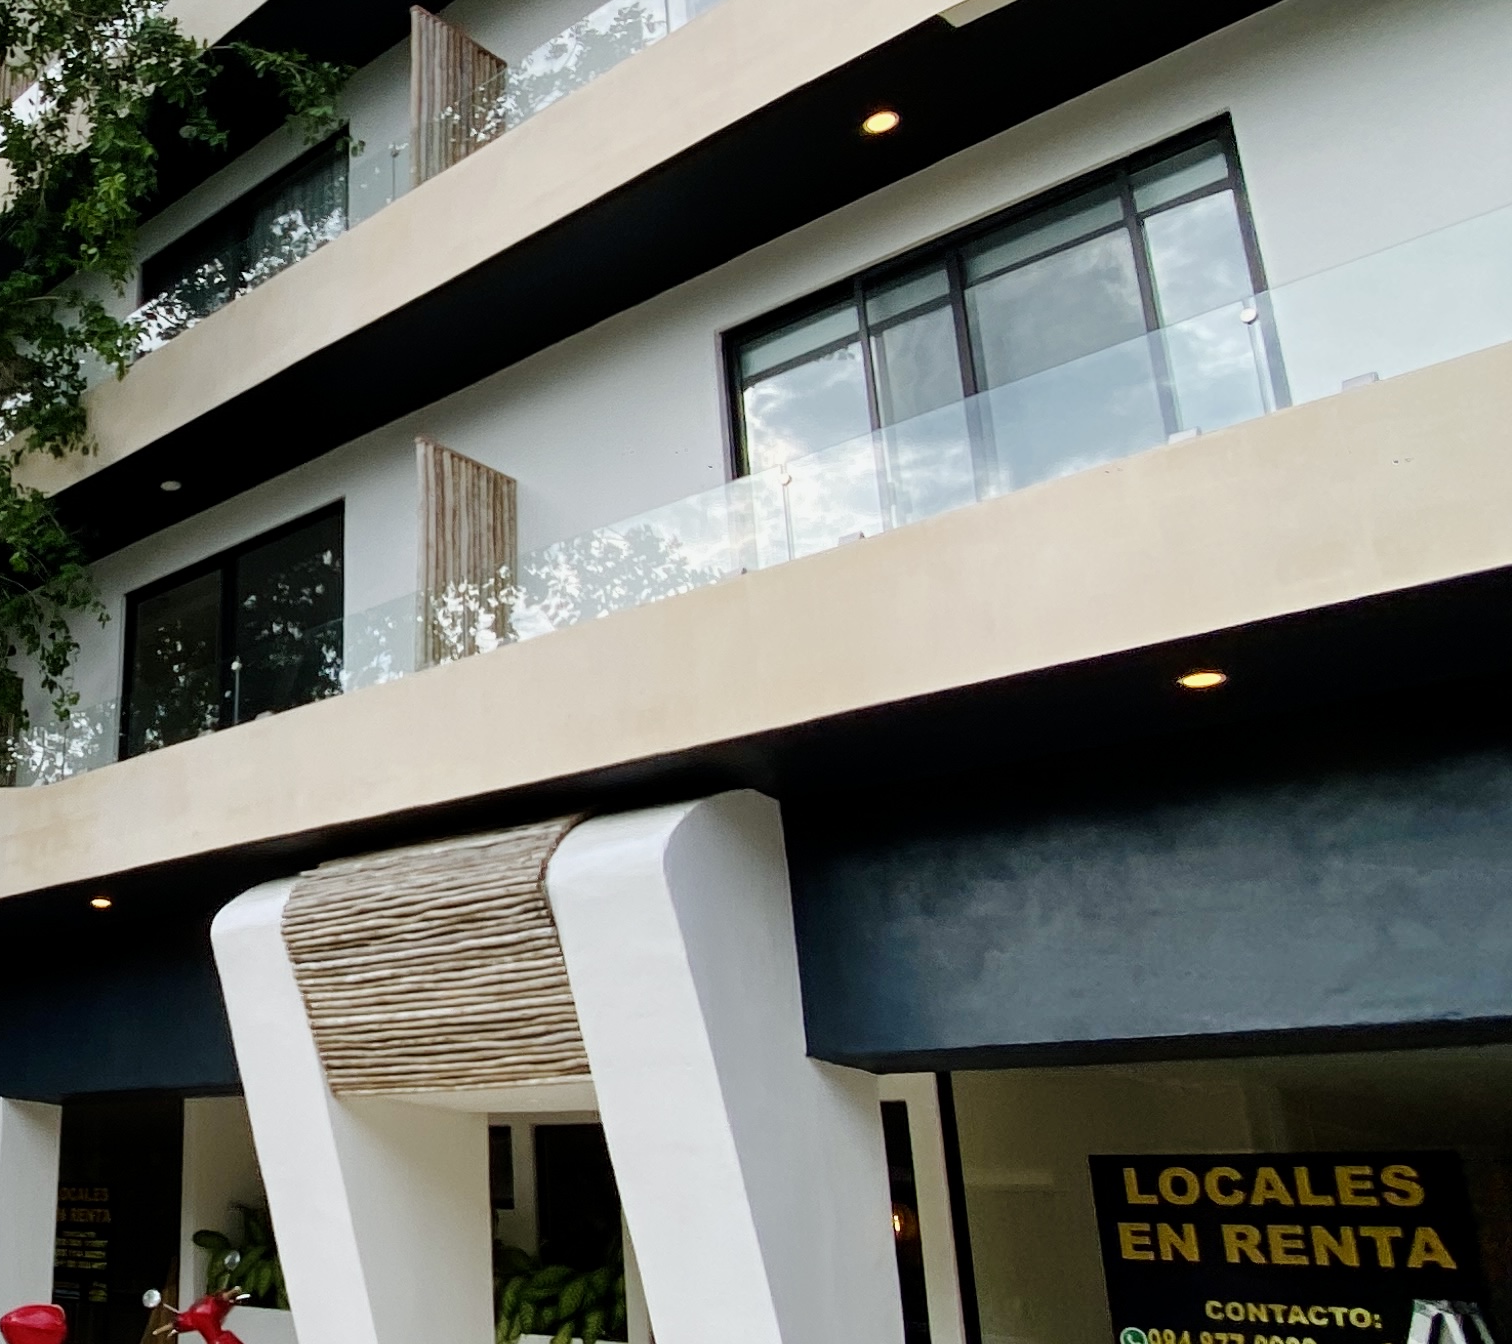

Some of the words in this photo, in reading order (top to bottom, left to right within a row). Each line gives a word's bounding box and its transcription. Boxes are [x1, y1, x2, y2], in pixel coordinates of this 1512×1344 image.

[1122, 1165, 1426, 1207] LOCALES
[1117, 1222, 1201, 1263] EN
[1220, 1224, 1458, 1269] RENTA
[1204, 1300, 1383, 1329] CONTACTO:
